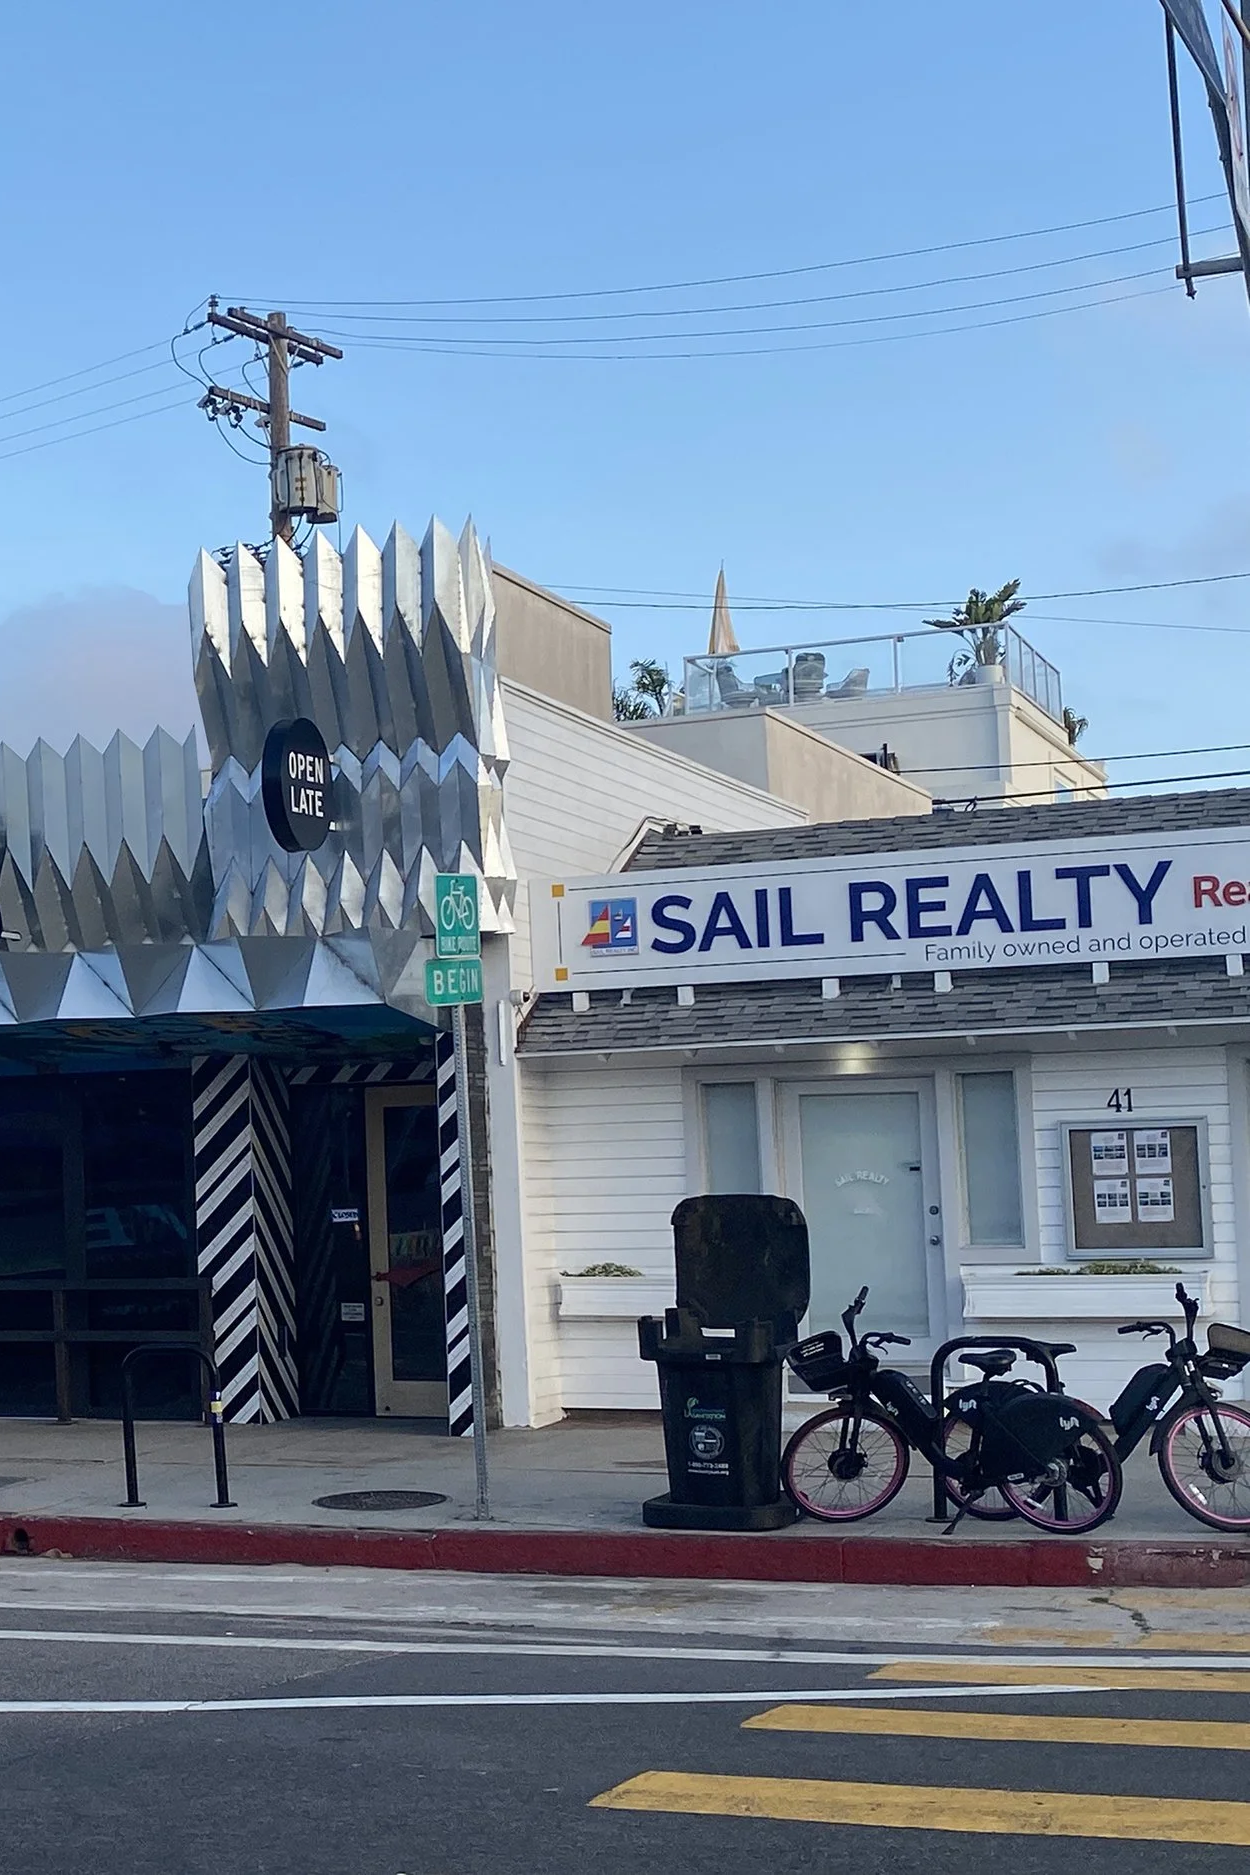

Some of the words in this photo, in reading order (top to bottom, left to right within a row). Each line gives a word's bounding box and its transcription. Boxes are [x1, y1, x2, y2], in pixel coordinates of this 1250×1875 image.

[288, 751, 325, 784] OPEN
[290, 785, 325, 818] LATE
[650, 885, 825, 955] SAIL
[848, 859, 1174, 943] REALTY
[1192, 875, 1250, 909] Re
[924, 941, 997, 964] Family
[1002, 934, 1081, 957] owned
[1087, 931, 1132, 953] and
[1138, 925, 1248, 954] operated
[433, 967, 479, 996] BEGIN
[1107, 1087, 1134, 1113] 41
